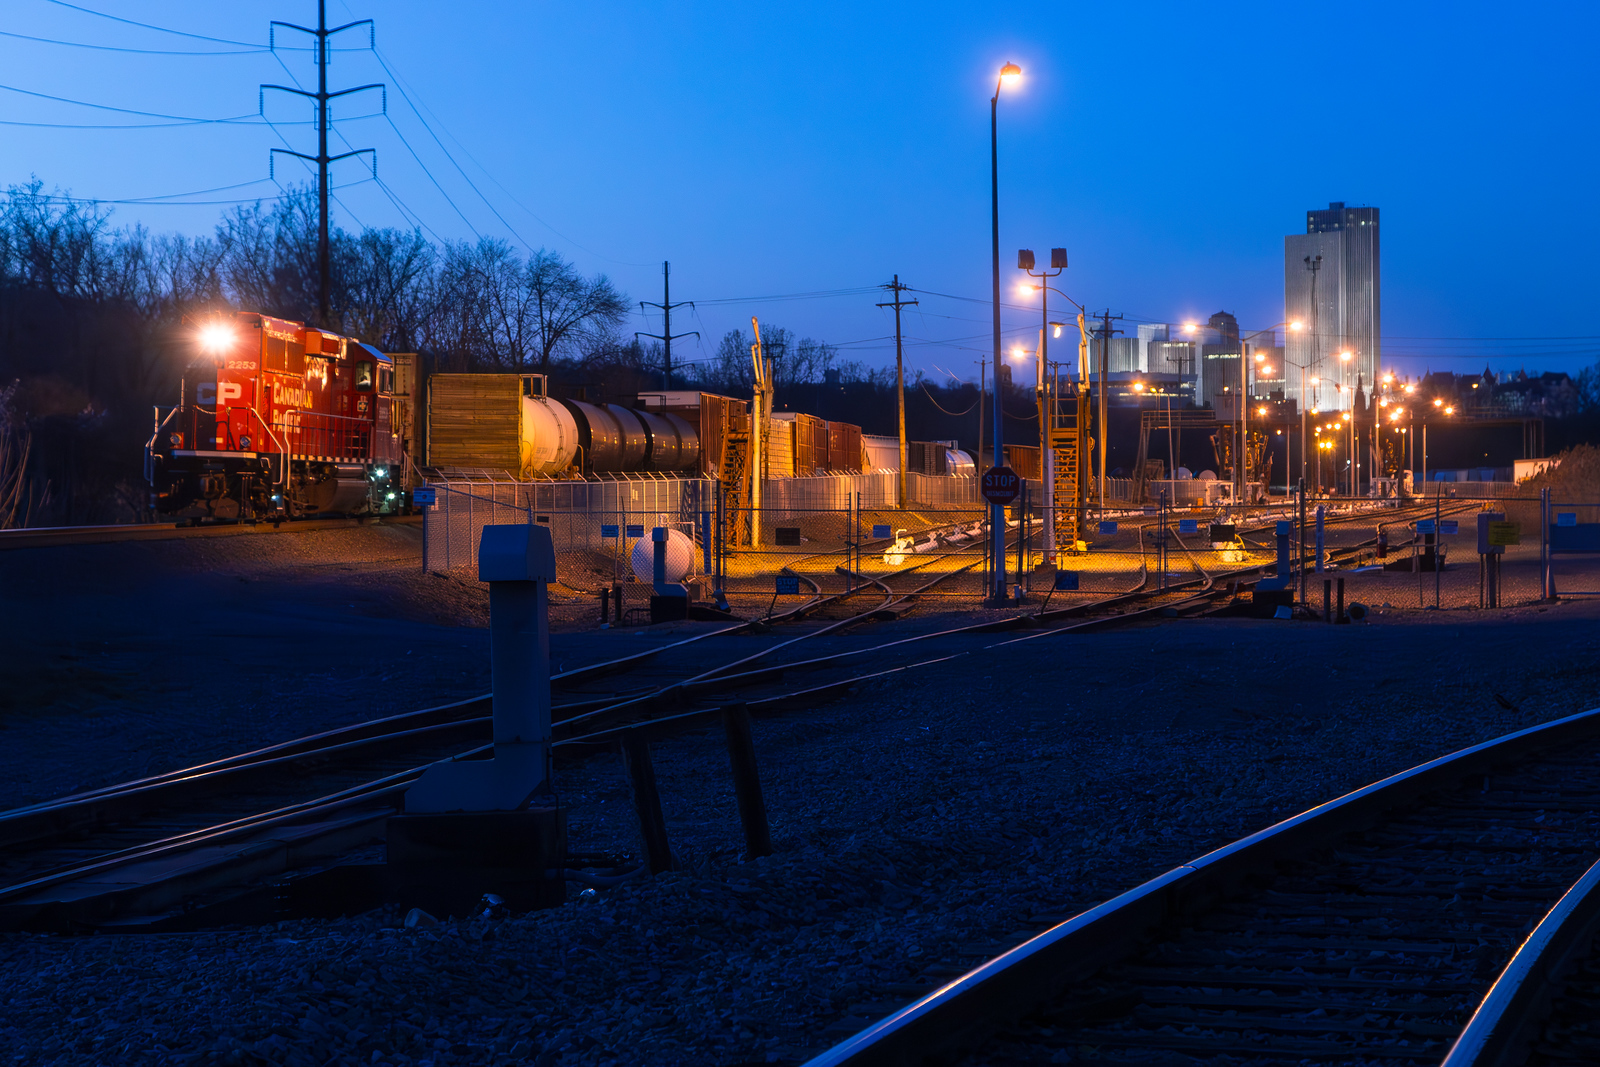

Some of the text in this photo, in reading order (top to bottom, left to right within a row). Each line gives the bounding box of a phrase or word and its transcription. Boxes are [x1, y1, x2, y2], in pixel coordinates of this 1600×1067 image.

[228, 361, 256, 370] 2253
[197, 382, 242, 405] CP
[985, 474, 1016, 487] STOP
